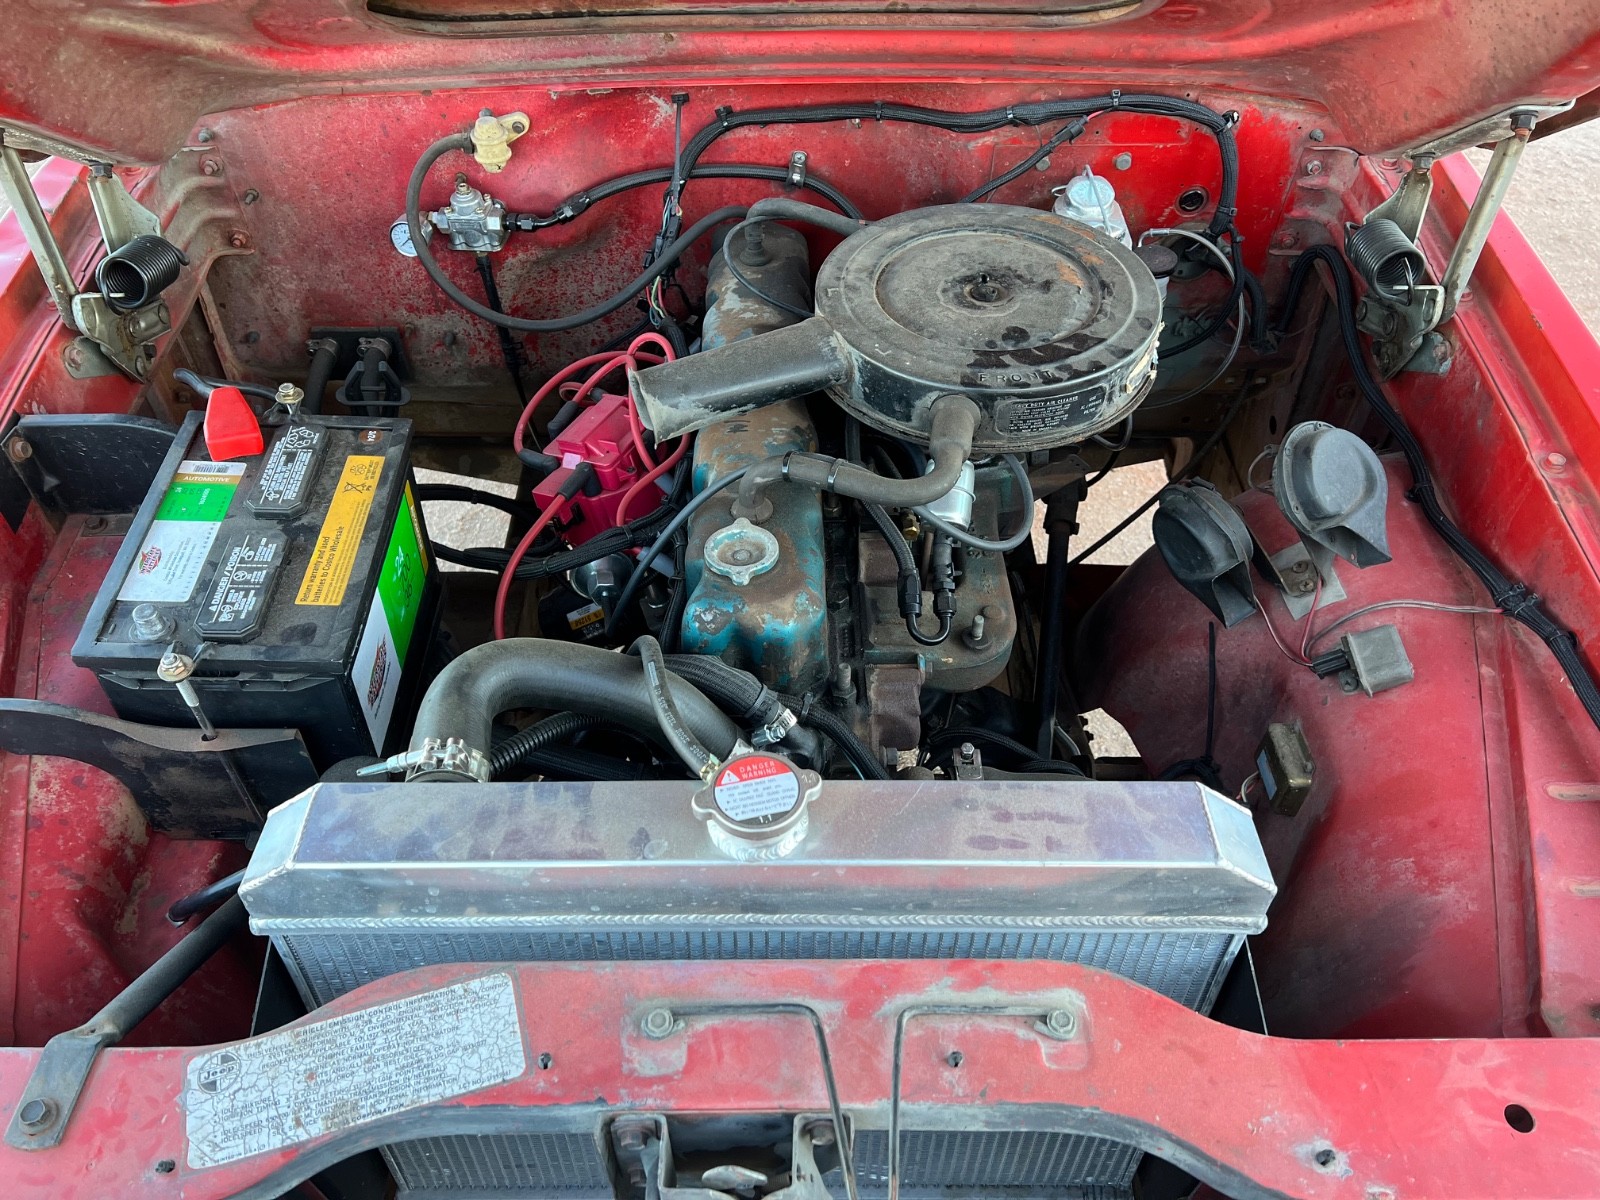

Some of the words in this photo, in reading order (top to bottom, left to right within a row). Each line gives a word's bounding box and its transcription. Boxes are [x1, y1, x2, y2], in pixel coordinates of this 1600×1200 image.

[979, 369, 1053, 382] FRONT
[319, 536, 330, 548] used
[328, 526, 344, 551] Wholesale
[315, 550, 325, 559] and
[322, 552, 335, 570] Costco
[211, 575, 229, 604] DANGER
[224, 545, 241, 571] POISON
[307, 560, 323, 582] warranty
[299, 583, 313, 602] Return
[311, 578, 326, 602] batteries
[675, 728, 690, 743] HOSE
[740, 761, 775, 773] DANGER
[742, 768, 777, 779] WARNING
[328, 1013, 364, 1028] EMISSION
[368, 1003, 402, 1017] CONTROL
[405, 988, 456, 1006] INFORMATION
[354, 1035, 362, 1043] TO
[407, 1018, 424, 1028] YEAR
[202, 1062, 236, 1081] Jeep
[288, 1117, 317, 1132] SEVICE
